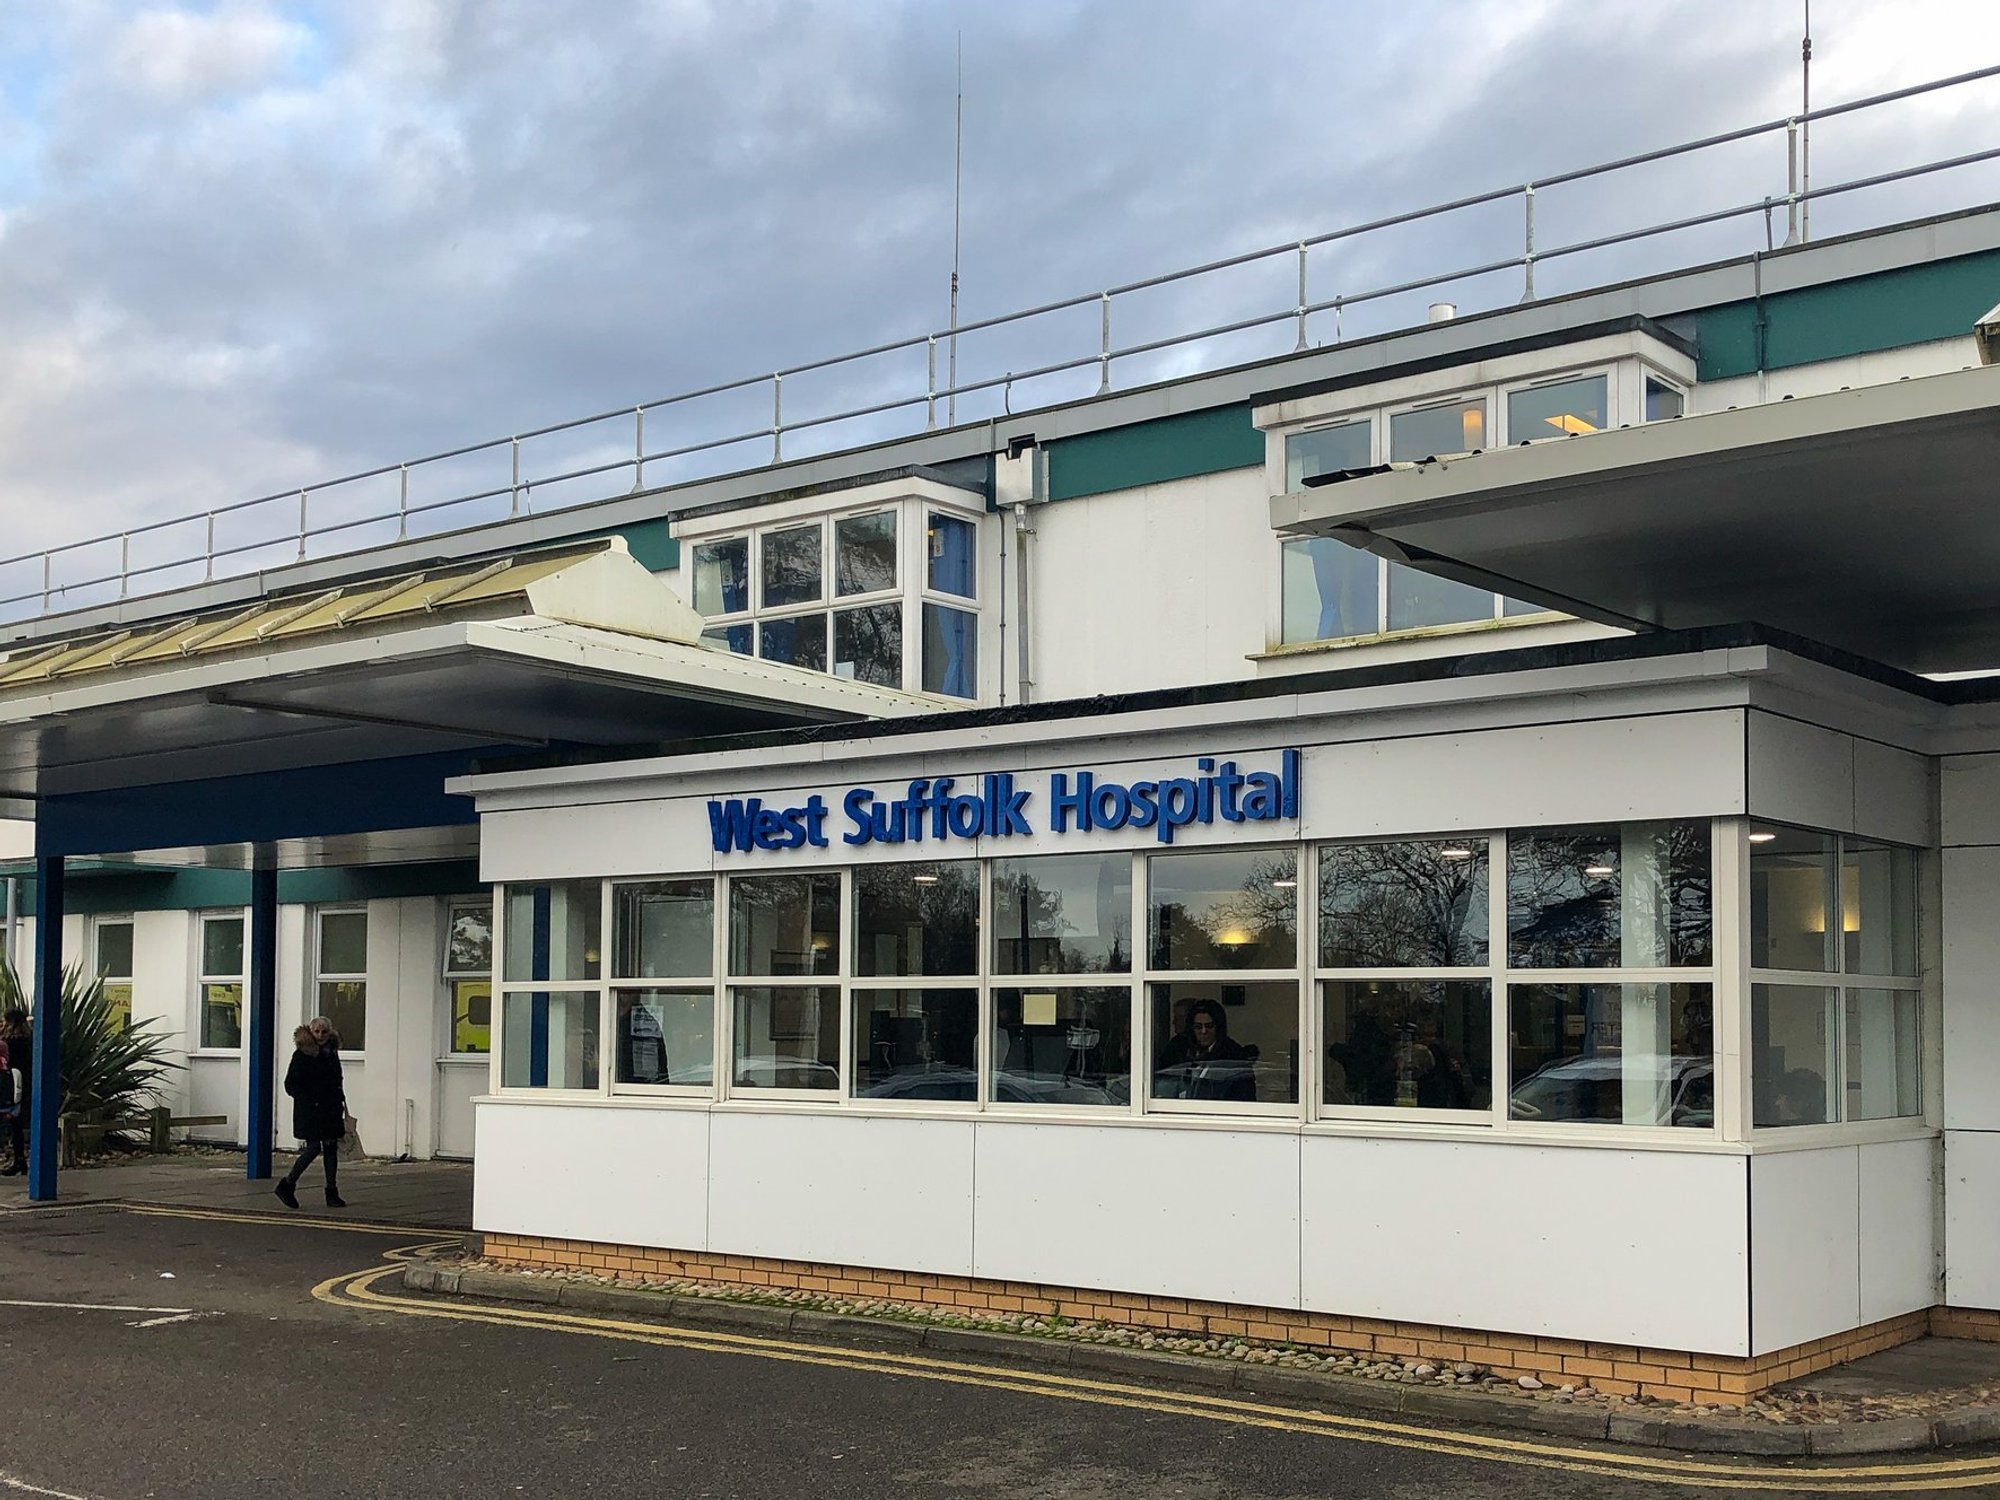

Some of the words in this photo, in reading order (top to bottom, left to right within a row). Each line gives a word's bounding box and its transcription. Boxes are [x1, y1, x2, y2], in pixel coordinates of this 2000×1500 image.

[708, 796, 828, 852] West
[844, 774, 1031, 845] Suffolk
[1051, 749, 1299, 843] Hospital
